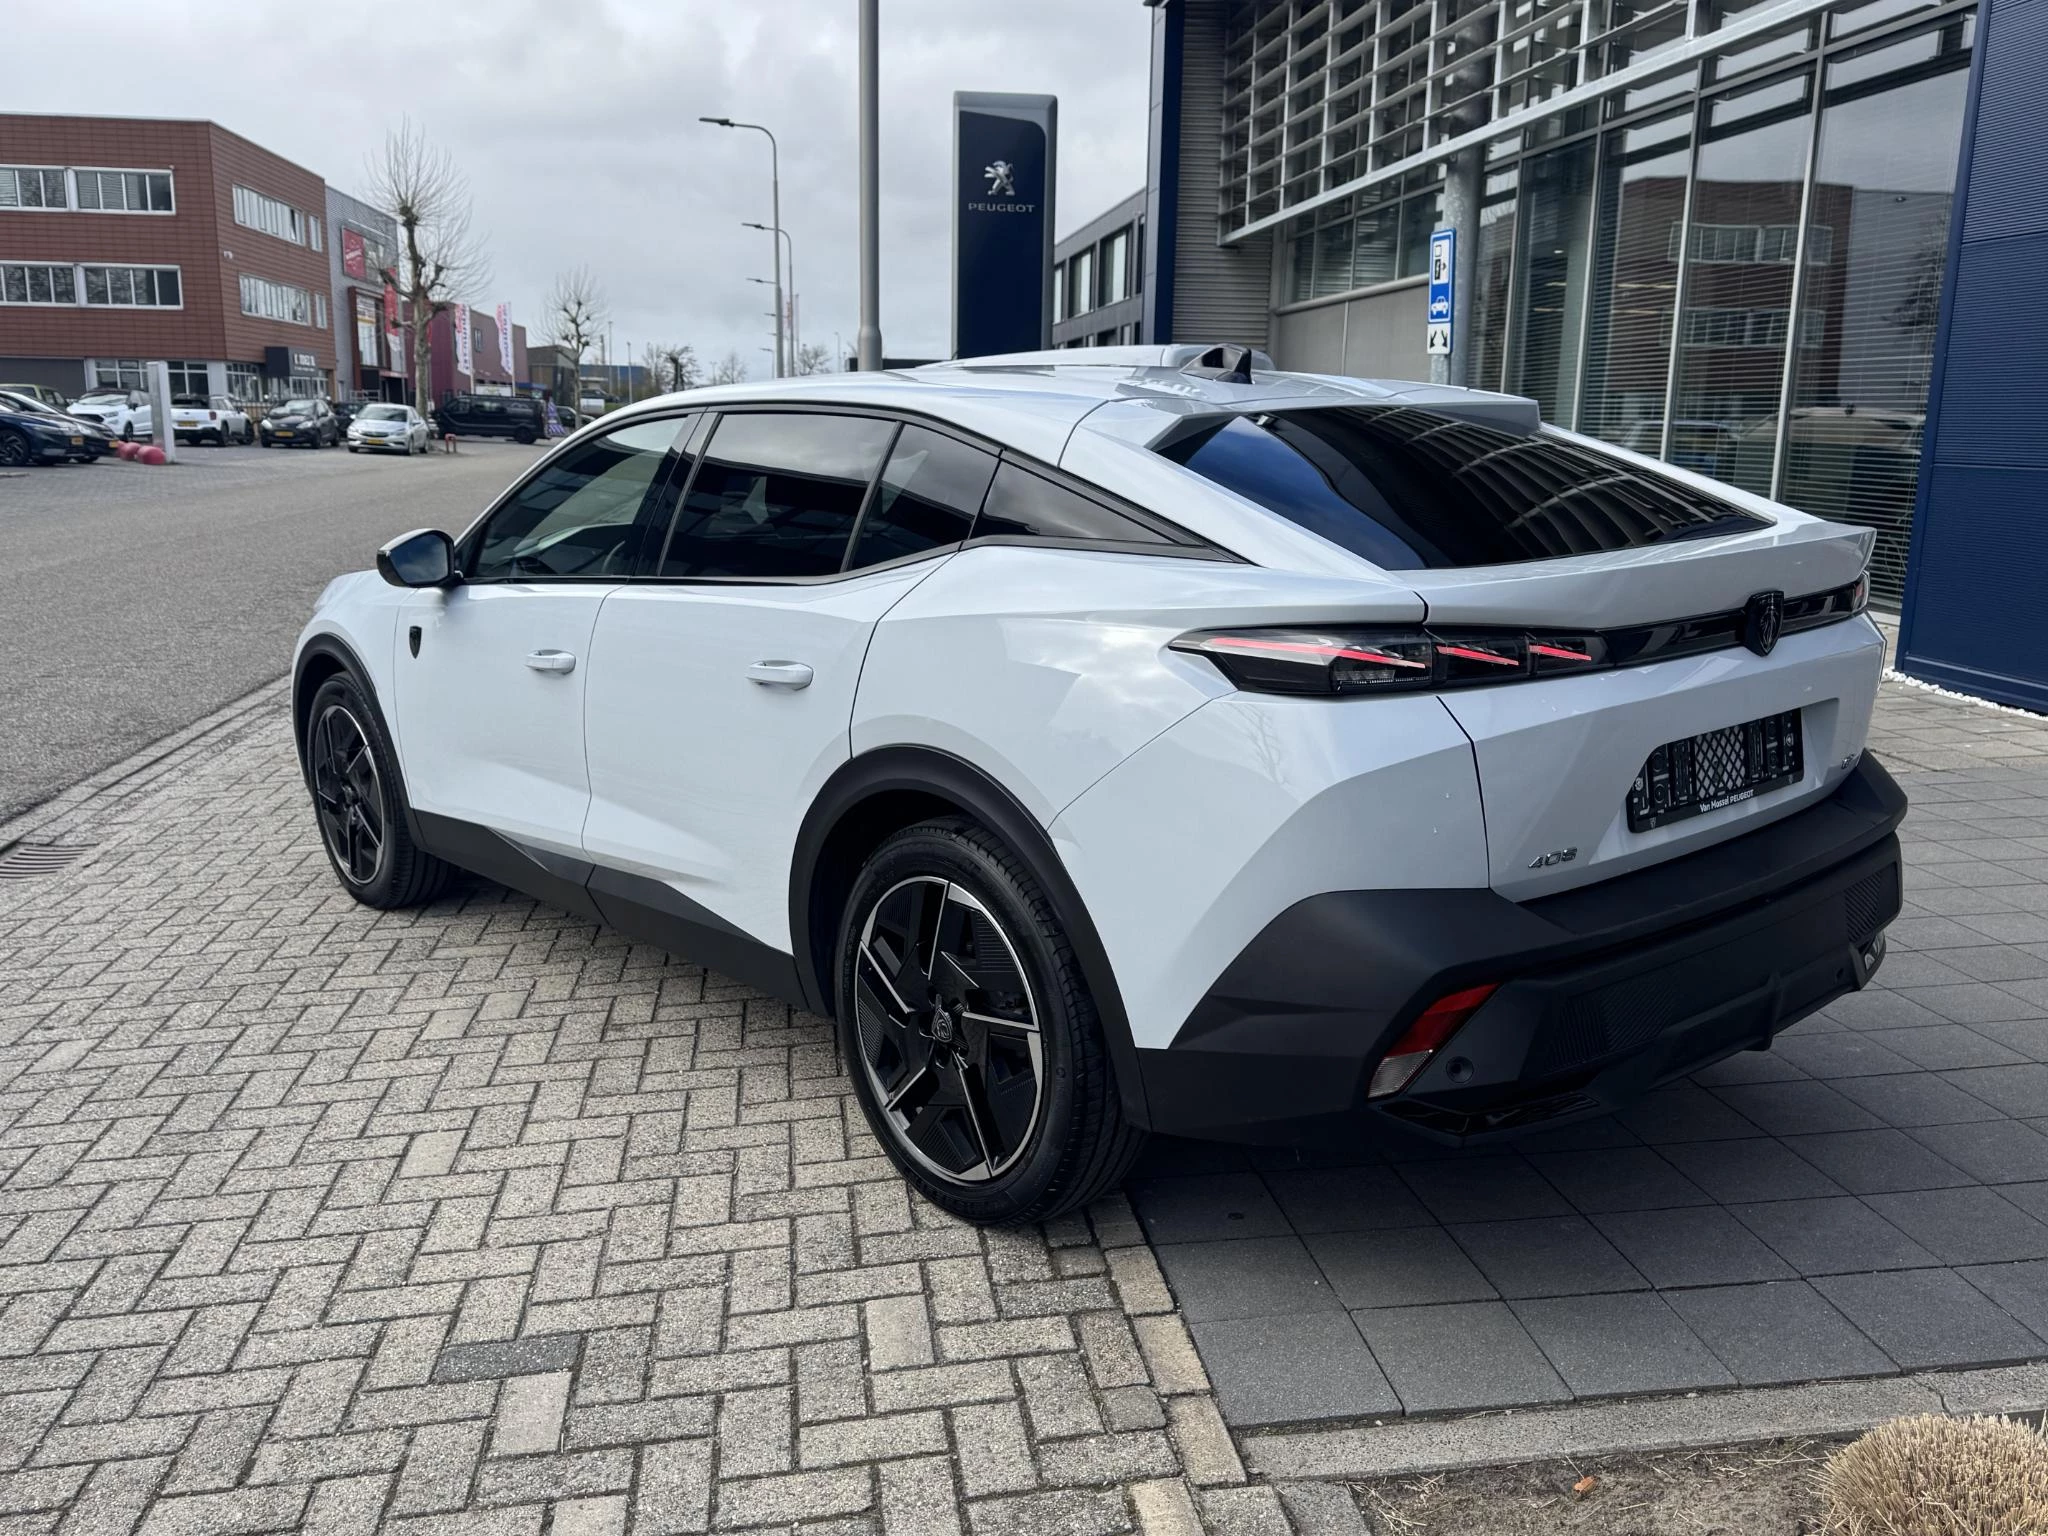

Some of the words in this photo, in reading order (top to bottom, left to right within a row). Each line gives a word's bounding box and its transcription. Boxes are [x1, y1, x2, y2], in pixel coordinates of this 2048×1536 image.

[968, 202, 1036, 213] PEUGEOT
[1700, 803, 1711, 813] Van
[1711, 795, 1730, 810] Mossel
[1730, 789, 1754, 804] PEUGEOT
